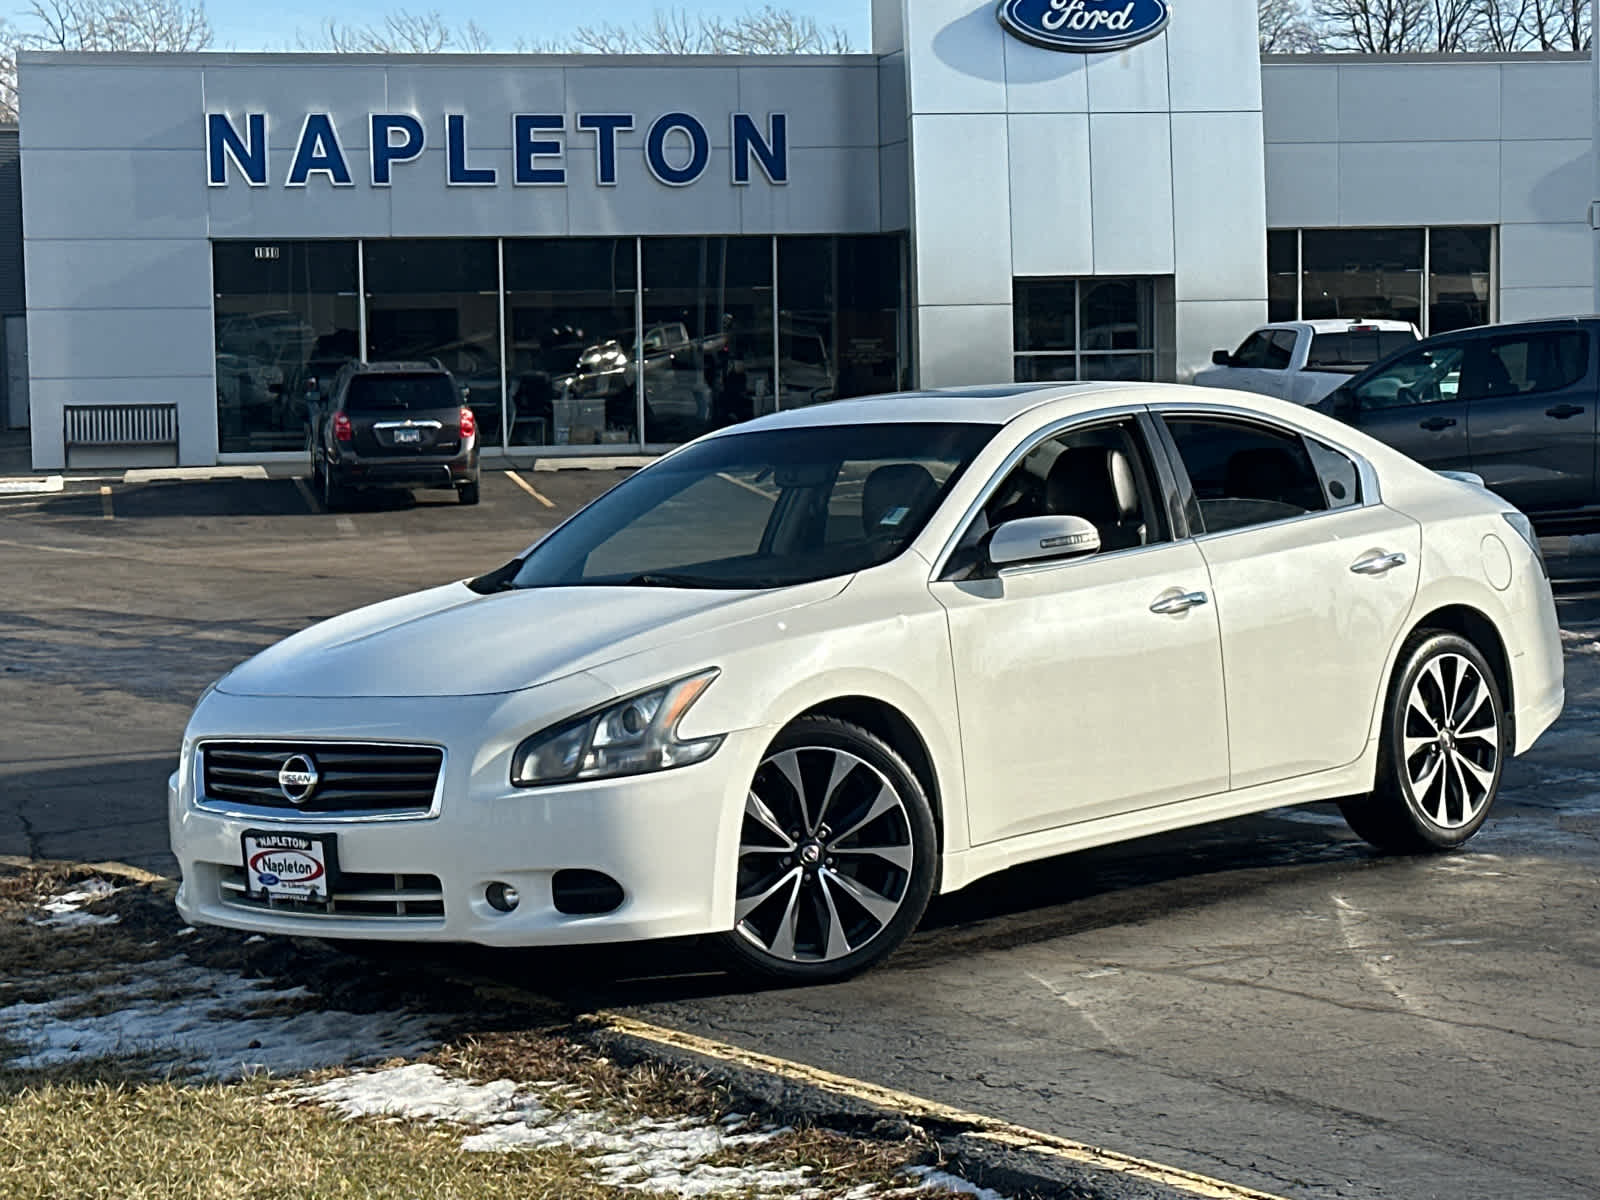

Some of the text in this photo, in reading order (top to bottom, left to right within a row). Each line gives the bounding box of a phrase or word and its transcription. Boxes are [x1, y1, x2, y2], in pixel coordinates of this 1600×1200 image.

[1042, 0, 1135, 30] Ford
[204, 111, 789, 188] NAPLETON
[281, 774, 311, 784] NISSAN
[259, 836, 308, 849] NAPLETON
[262, 855, 312, 876] Napleton
